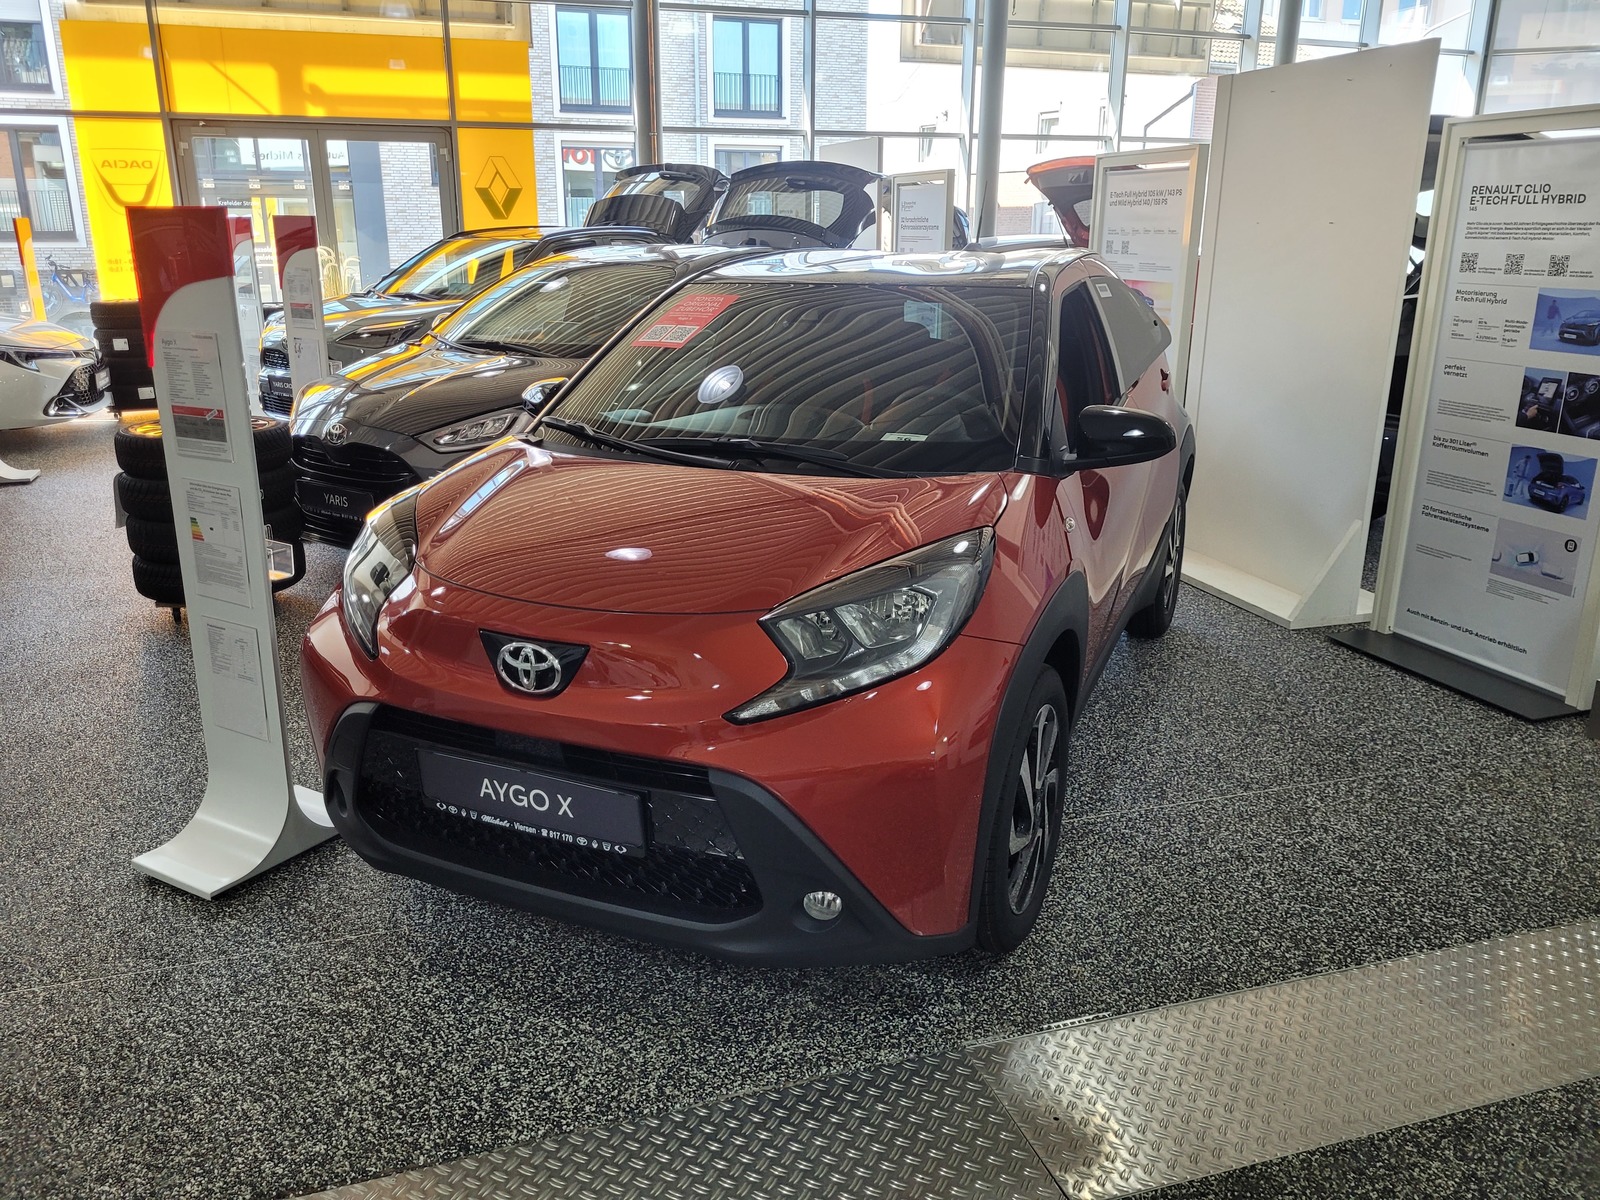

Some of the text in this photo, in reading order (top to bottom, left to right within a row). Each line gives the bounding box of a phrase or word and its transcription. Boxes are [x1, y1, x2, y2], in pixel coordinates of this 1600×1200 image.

[1110, 191, 1124, 199] E-Tech
[1124, 190, 1132, 198] Full
[1132, 190, 1148, 200] Hybrid
[1156, 189, 1164, 197] kW
[1176, 188, 1182, 196] PS
[1472, 183, 1552, 195] RENAULT CLIO
[1109, 198, 1117, 206] und
[1128, 198, 1142, 208] Hybrid
[1161, 197, 1168, 206] PS
[1470, 193, 1587, 206] E-TECH FULL HYBRID
[1456, 289, 1498, 298] Motorisierung
[1444, 364, 1466, 372] perfekt
[1432, 441, 1489, 457] Kofferraumvolumen
[324, 493, 348, 507] YARIS
[1430, 506, 1472, 521] fortschrittliche
[1422, 510, 1489, 532] Fahrerassistenzsysteme
[1406, 608, 1420, 616] Auch
[1430, 616, 1450, 626] Benzin-
[1462, 627, 1497, 643] LPG-Antrieb
[1497, 641, 1527, 654] erhältlich
[480, 778, 574, 818] AYGO X
[481, 814, 573, 843] Michels Viersen 817 170
